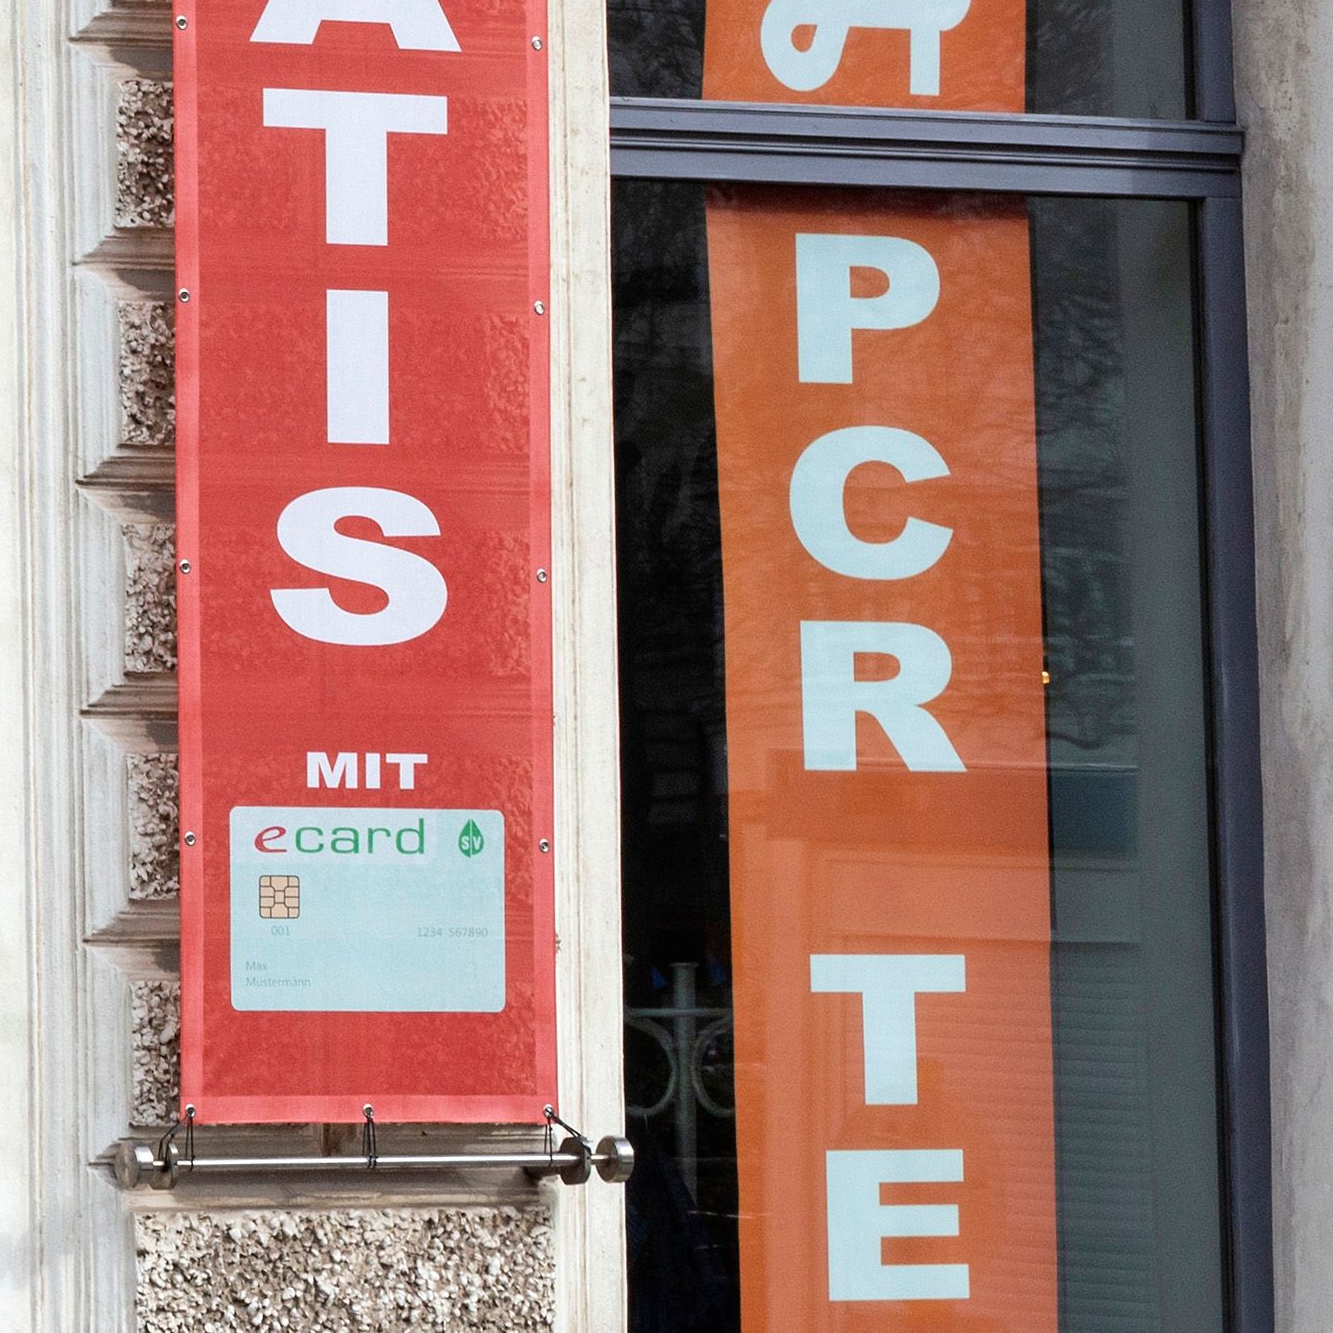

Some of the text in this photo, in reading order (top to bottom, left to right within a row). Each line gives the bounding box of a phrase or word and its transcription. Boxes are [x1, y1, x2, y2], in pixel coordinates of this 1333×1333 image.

[789, 233, 967, 773] PCR
[306, 751, 428, 790] MIT
[270, 925, 290, 936] 001
[417, 927, 489, 938] 1234 567890
[245, 961, 267, 972] Max
[245, 977, 312, 988] Mustermann
